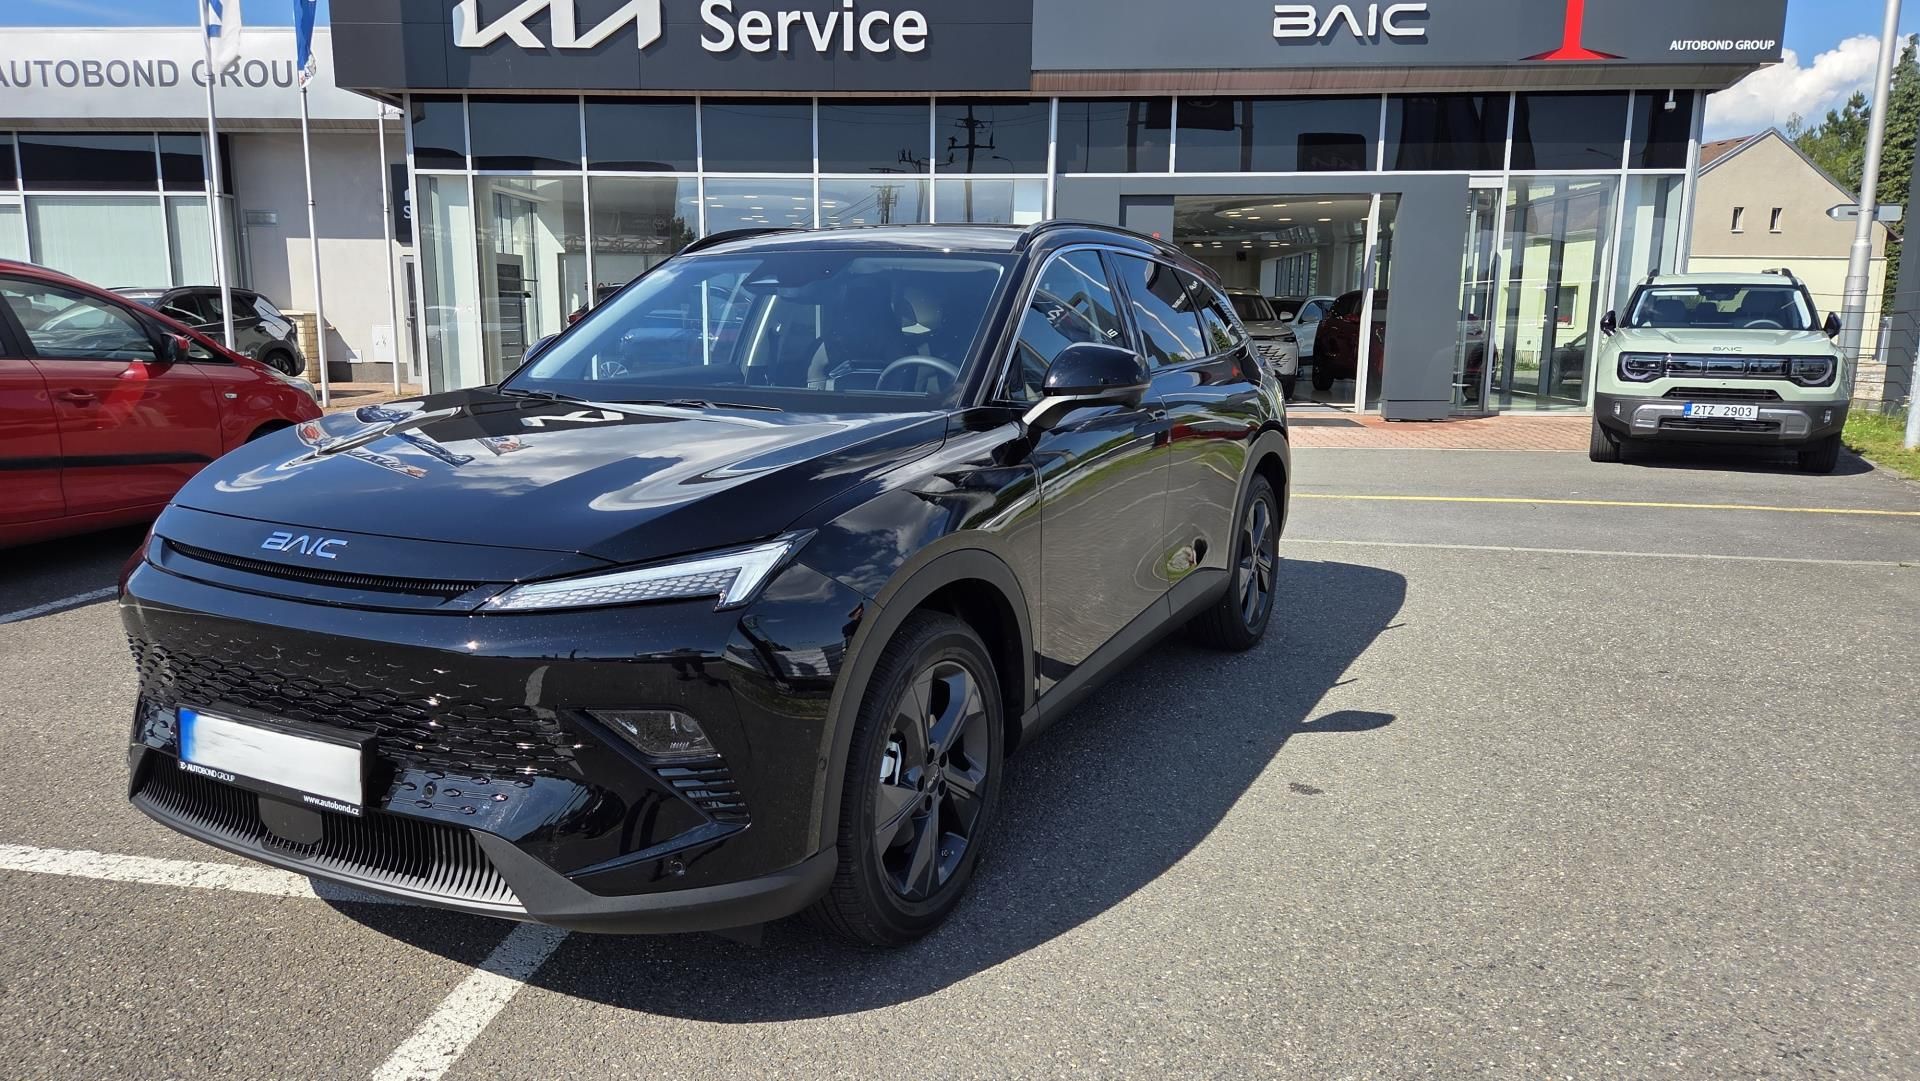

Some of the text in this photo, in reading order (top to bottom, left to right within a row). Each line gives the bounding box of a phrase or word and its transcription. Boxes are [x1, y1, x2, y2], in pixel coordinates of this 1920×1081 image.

[700, 0, 928, 52] Service
[1273, 3, 1427, 37] BAIC
[1669, 40, 1775, 51] AUTOBOND GROUP
[191, 59, 297, 88] GROU
[1693, 405, 1752, 417] 2TZ 2903
[261, 531, 348, 559] BAIC
[186, 763, 236, 782] AUTOBOND GROUP
[303, 794, 360, 816] www.autobond.cz
